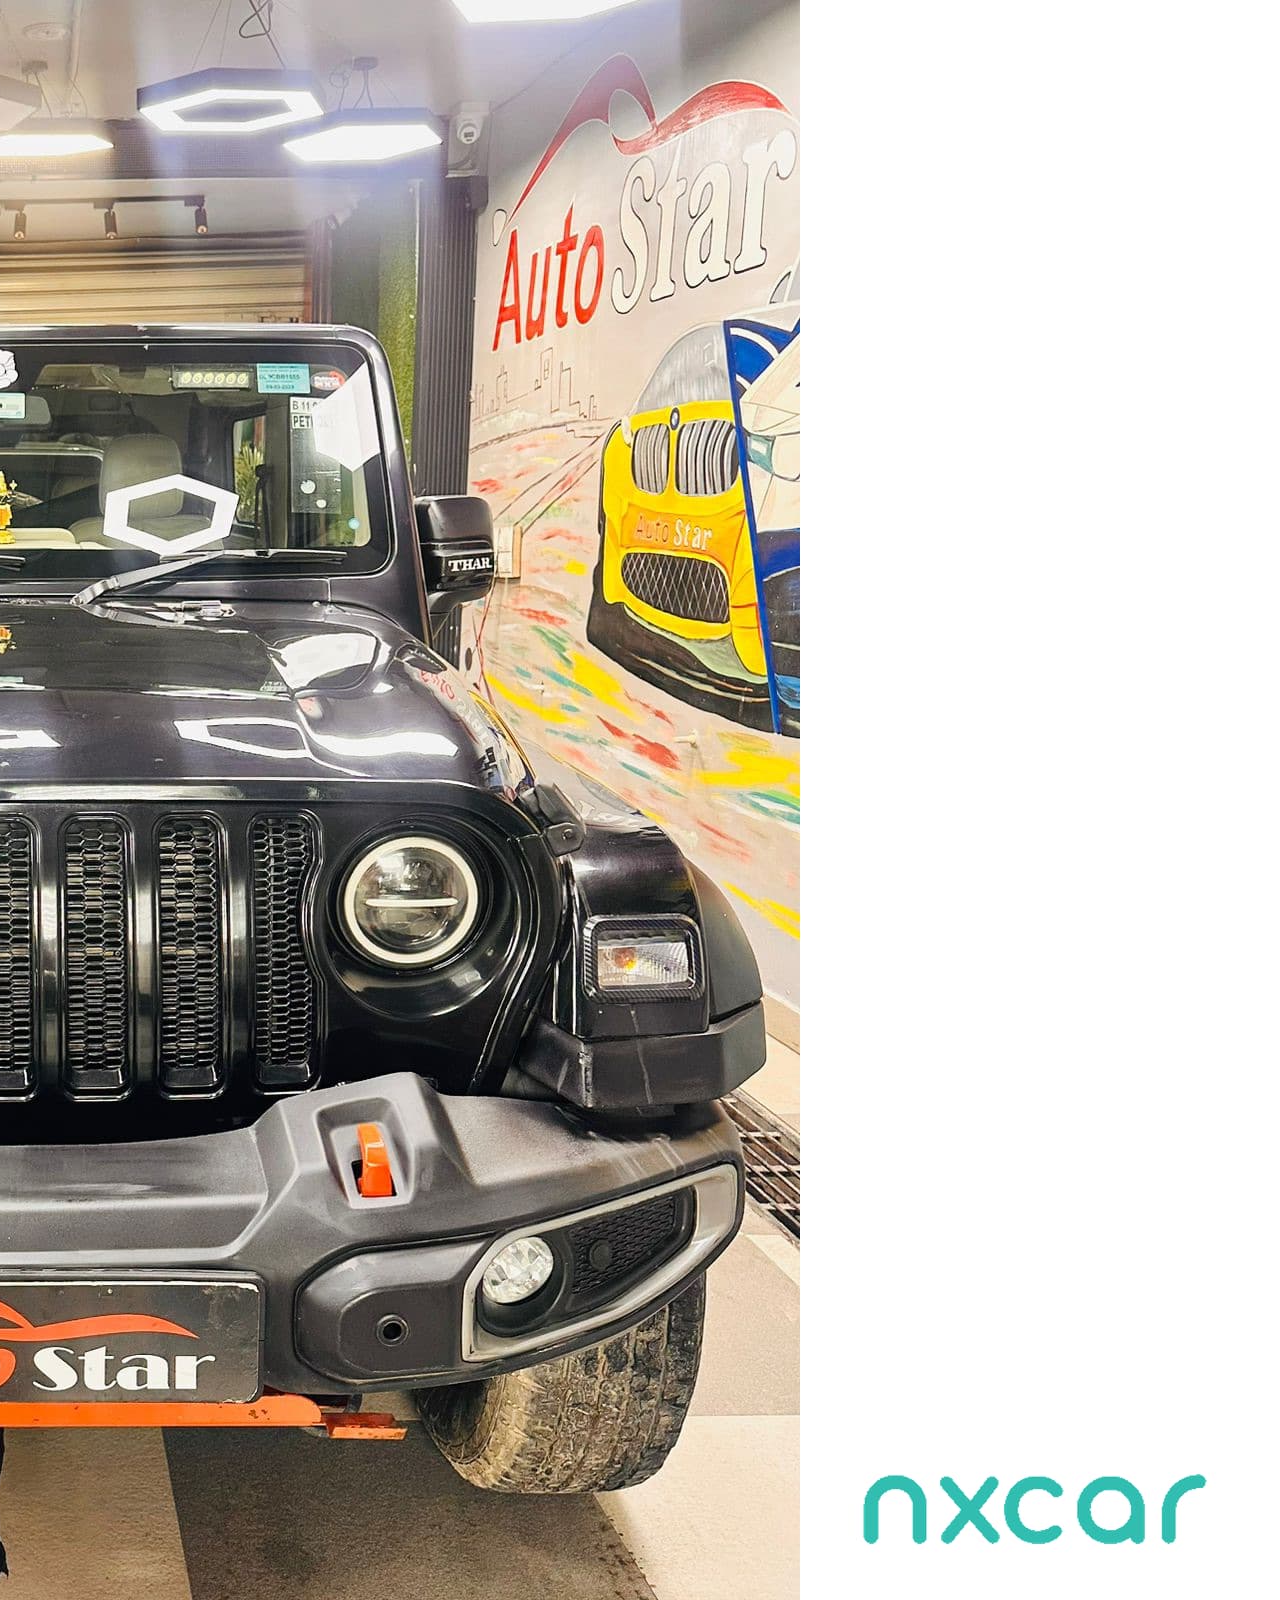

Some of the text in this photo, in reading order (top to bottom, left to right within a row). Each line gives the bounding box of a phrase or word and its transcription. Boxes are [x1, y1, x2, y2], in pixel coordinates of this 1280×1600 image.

[492, 130, 798, 352] Auto Star
[633, 514, 713, 551] Auto Star
[448, 557, 493, 572] THAR
[32, 1345, 216, 1391] Star
